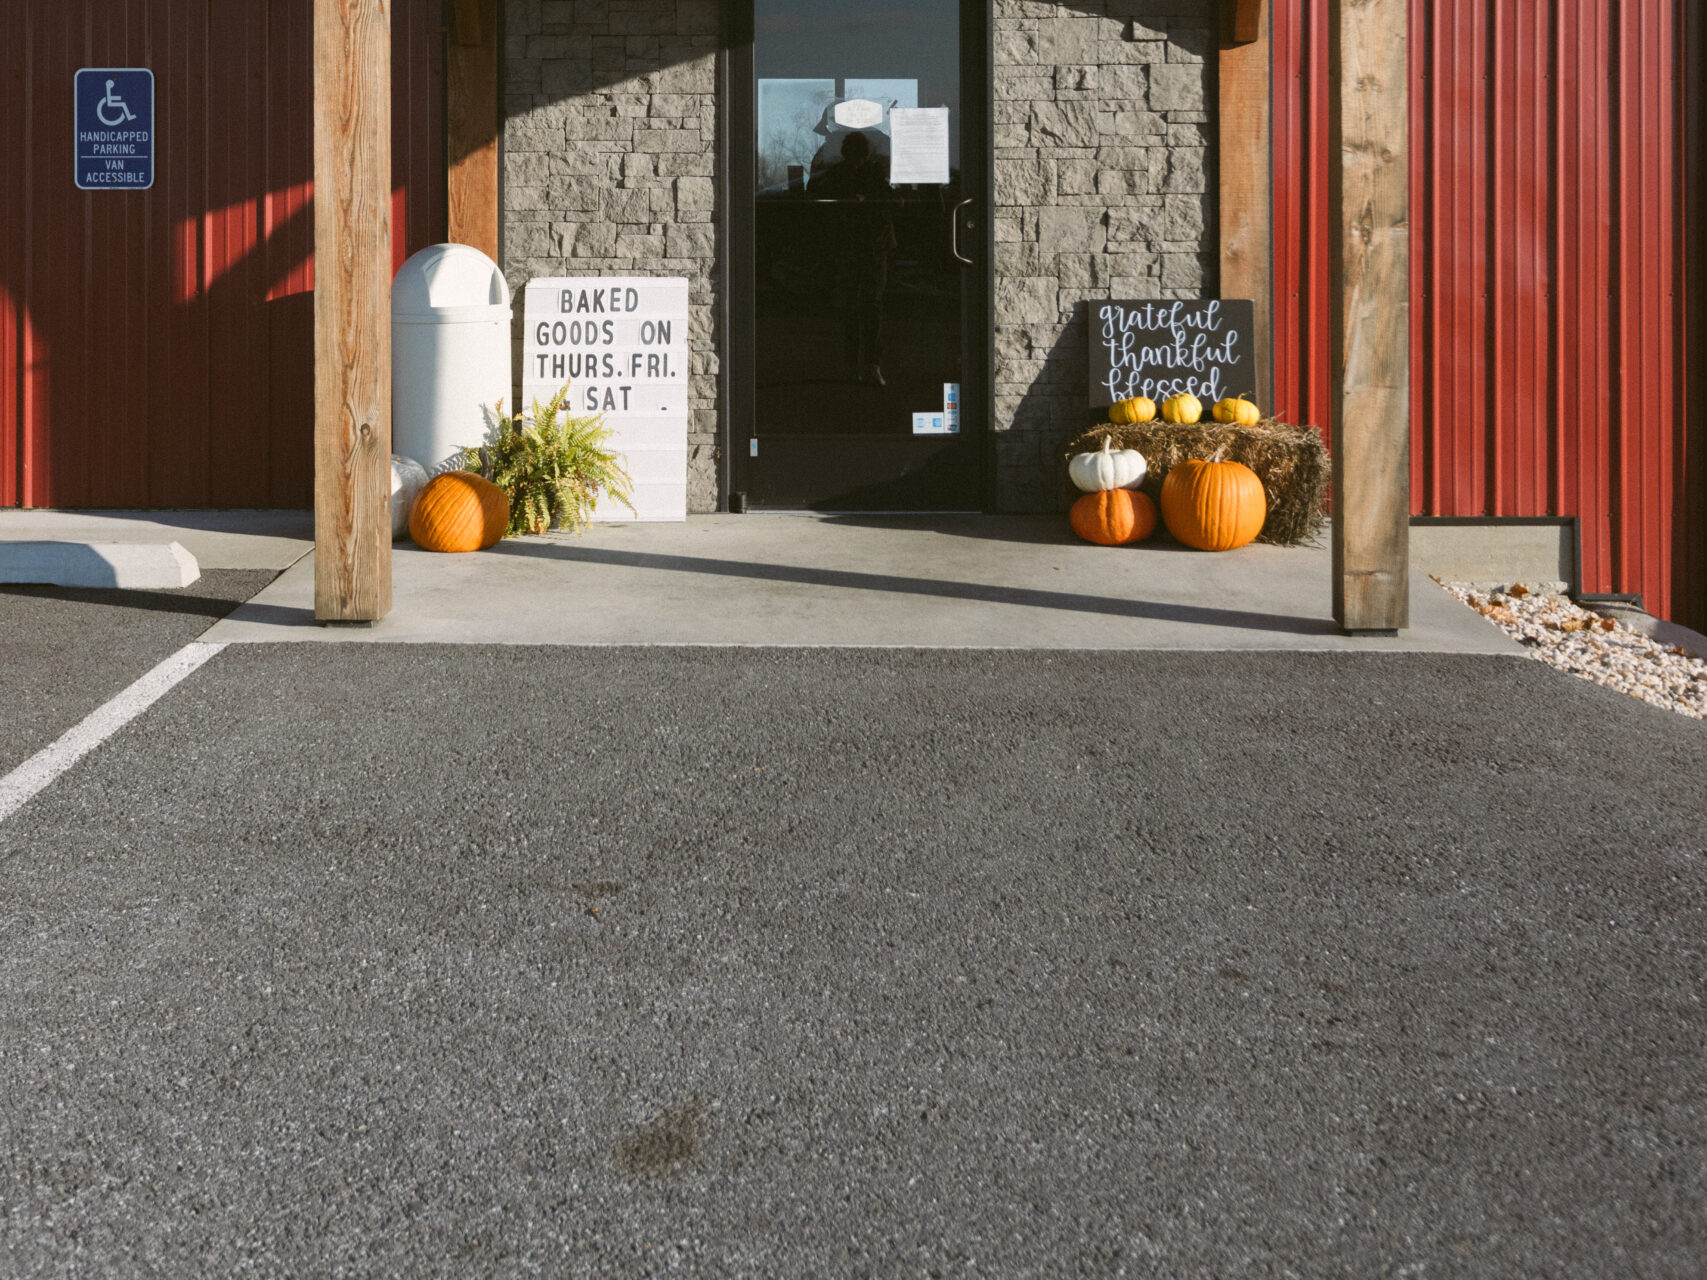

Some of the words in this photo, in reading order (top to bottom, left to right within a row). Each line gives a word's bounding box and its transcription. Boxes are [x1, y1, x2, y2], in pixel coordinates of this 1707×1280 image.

[80, 131, 148, 142] HANDICAPPED
[93, 144, 135, 155] PARKING
[86, 172, 145, 183] ACCESSIBLE
[105, 160, 124, 170] VAN
[560, 287, 638, 313] BAKED
[1099, 300, 1223, 339] grateful
[536, 320, 614, 346] GOODS
[640, 320, 671, 345] ON
[1102, 330, 1241, 372] thankful
[1101, 366, 1227, 403] blessed
